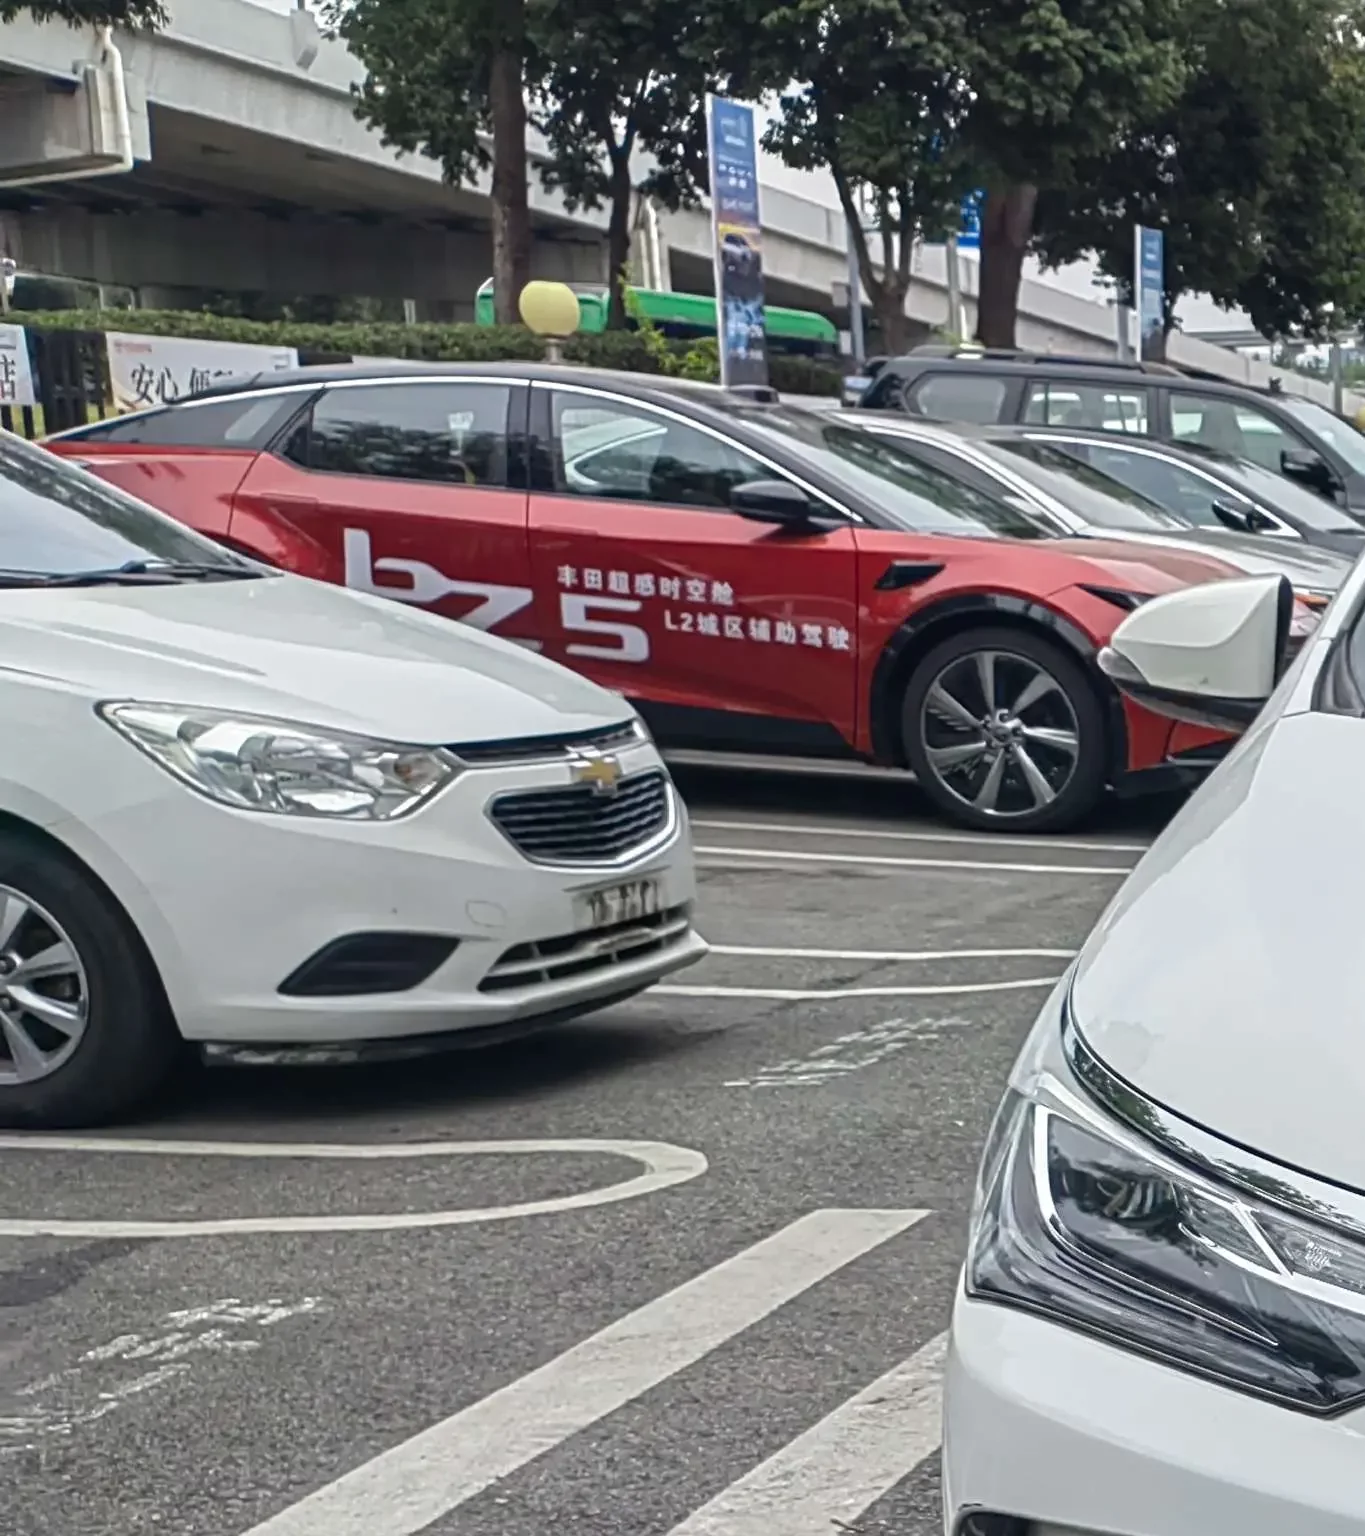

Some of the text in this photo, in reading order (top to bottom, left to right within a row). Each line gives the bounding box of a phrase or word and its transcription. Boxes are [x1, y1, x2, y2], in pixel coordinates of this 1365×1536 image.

[556, 564, 735, 606] 丰田超感时空舱
[663, 609, 850, 651] L2城区辅助驾驶
